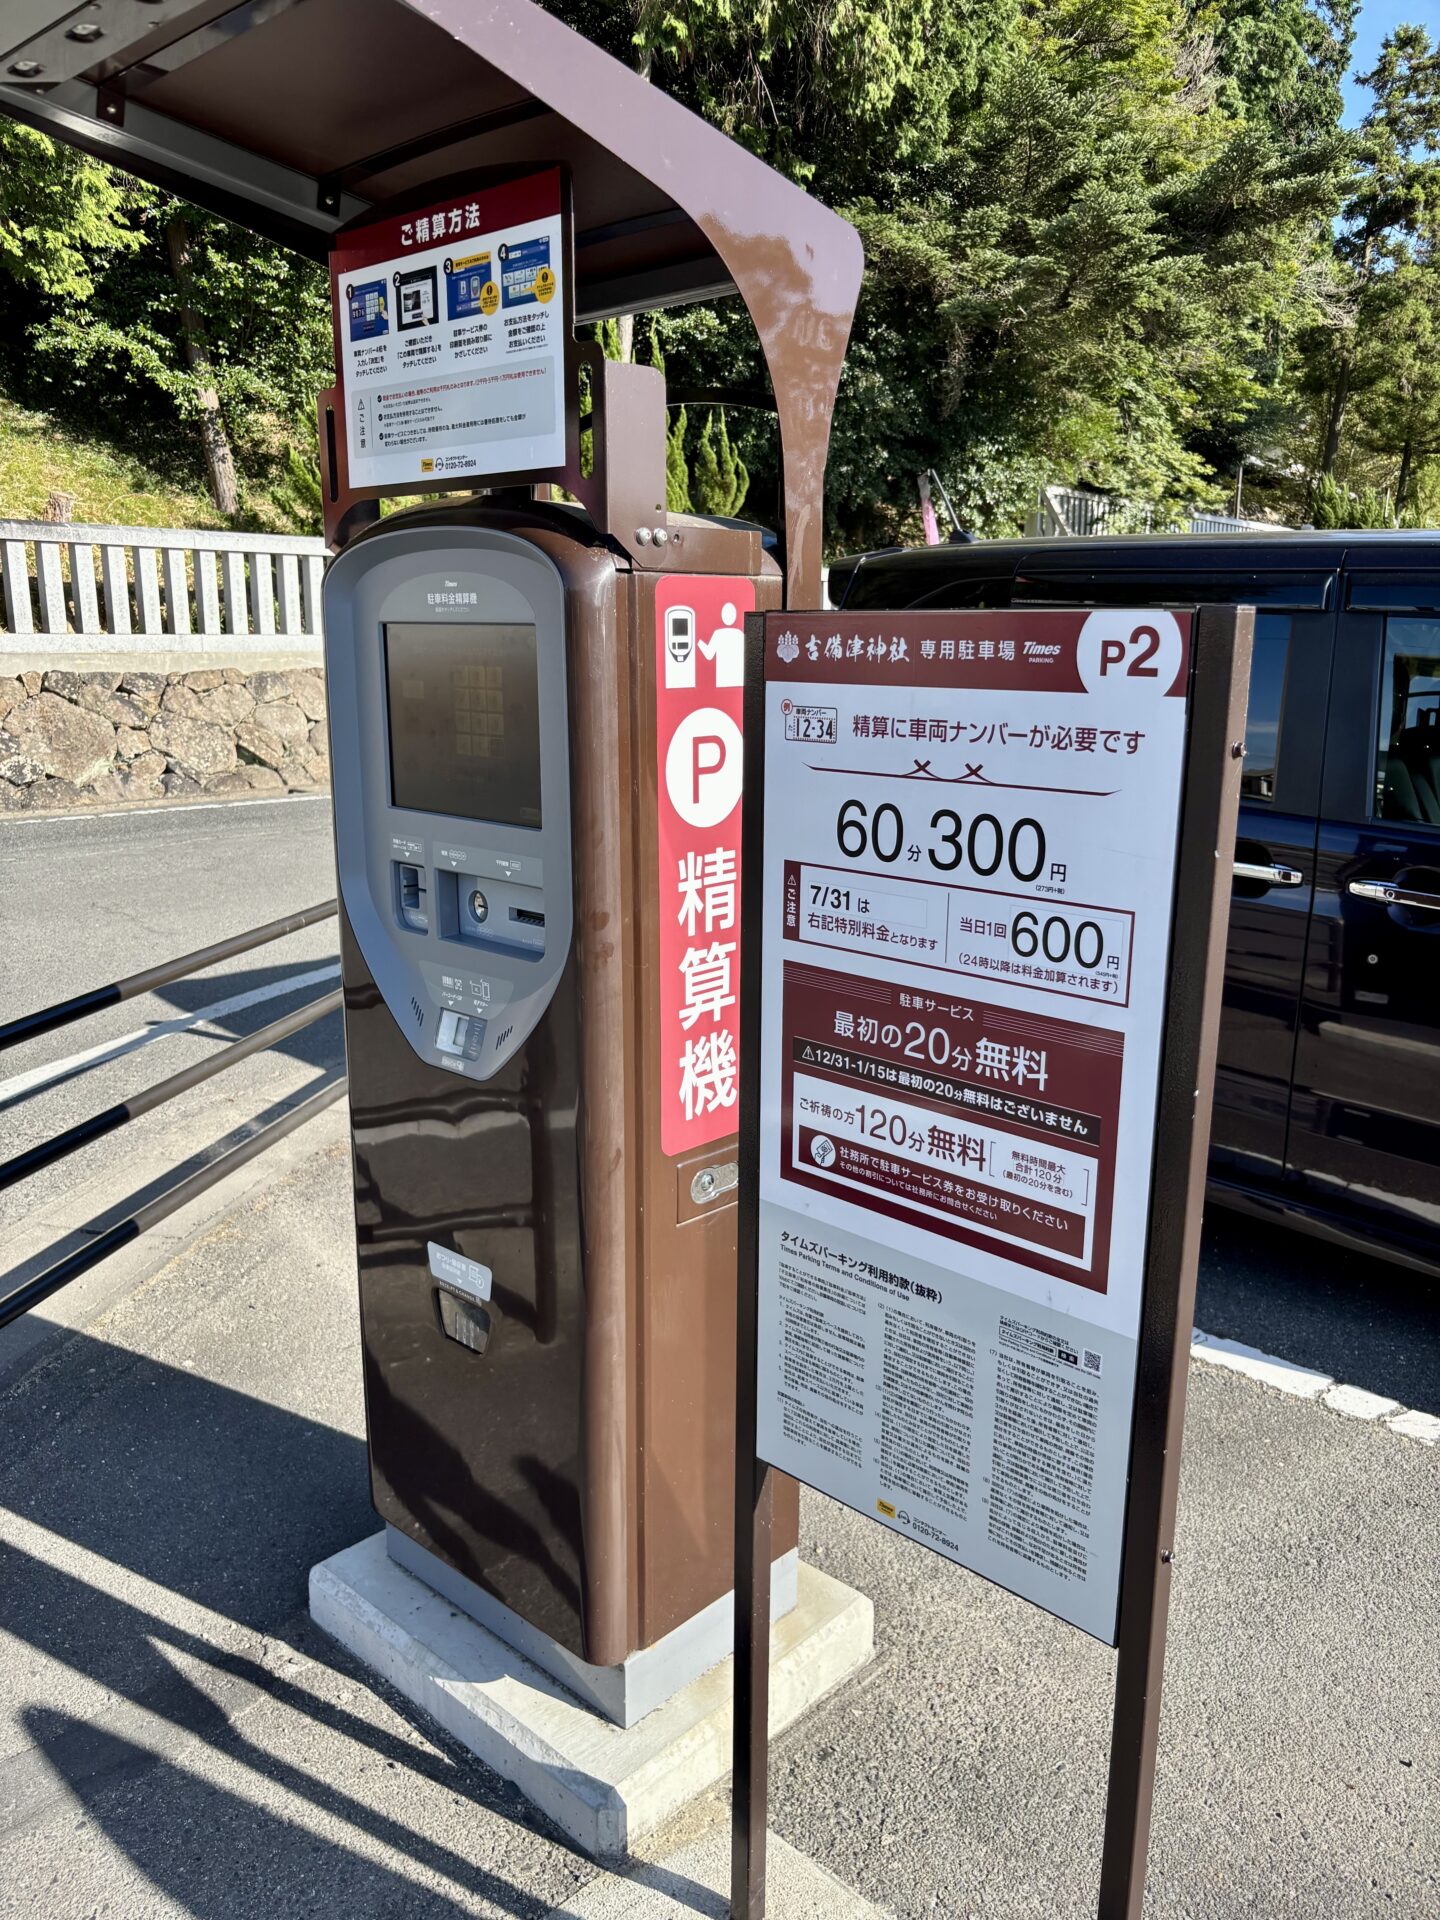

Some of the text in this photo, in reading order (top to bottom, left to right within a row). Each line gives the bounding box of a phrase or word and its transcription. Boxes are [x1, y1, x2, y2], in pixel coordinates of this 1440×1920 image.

[401, 202, 480, 247] ご精算方法
[427, 592, 477, 605] 駐車料金精算機
[805, 633, 1062, 664] 吉備津神社 専用駐車場 Times
[1028, 656, 1054, 664] PARKING
[1099, 625, 1161, 678] P2
[853, 714, 1146, 755] 精算に車両ナンバーが必要です
[691, 733, 727, 804] P
[786, 887, 797, 928] ご注意
[807, 912, 939, 952] 右記特別料金となります
[677, 847, 738, 1121] 精算機
[958, 952, 1118, 995] (24時以降は料金加算されます)
[899, 992, 974, 1021] 駐車サービス
[834, 1010, 1049, 1091] 最初の20分無料
[1011, 1150, 1066, 1175] 無料時間最大
[1015, 1162, 1062, 1184] 合計120分
[839, 1146, 1069, 1231] 社務所で駐車サービス券をお受け取りください
[839, 1160, 998, 1221] その他の割引については社務所にお問合せください
[1002, 1169, 1073, 1199] (最初の20分を含む)
[780, 1243, 798, 1257] Times
[798, 1251, 821, 1267] Parking
[822, 1260, 841, 1273] Terms
[841, 1268, 853, 1279] and
[854, 1274, 888, 1293] Conditions
[897, 1290, 910, 1302] Use
[781, 1230, 943, 1304] タイムズパーキング利用約款(抜粋)
[912, 1522, 959, 1551] 0120-72-8924
